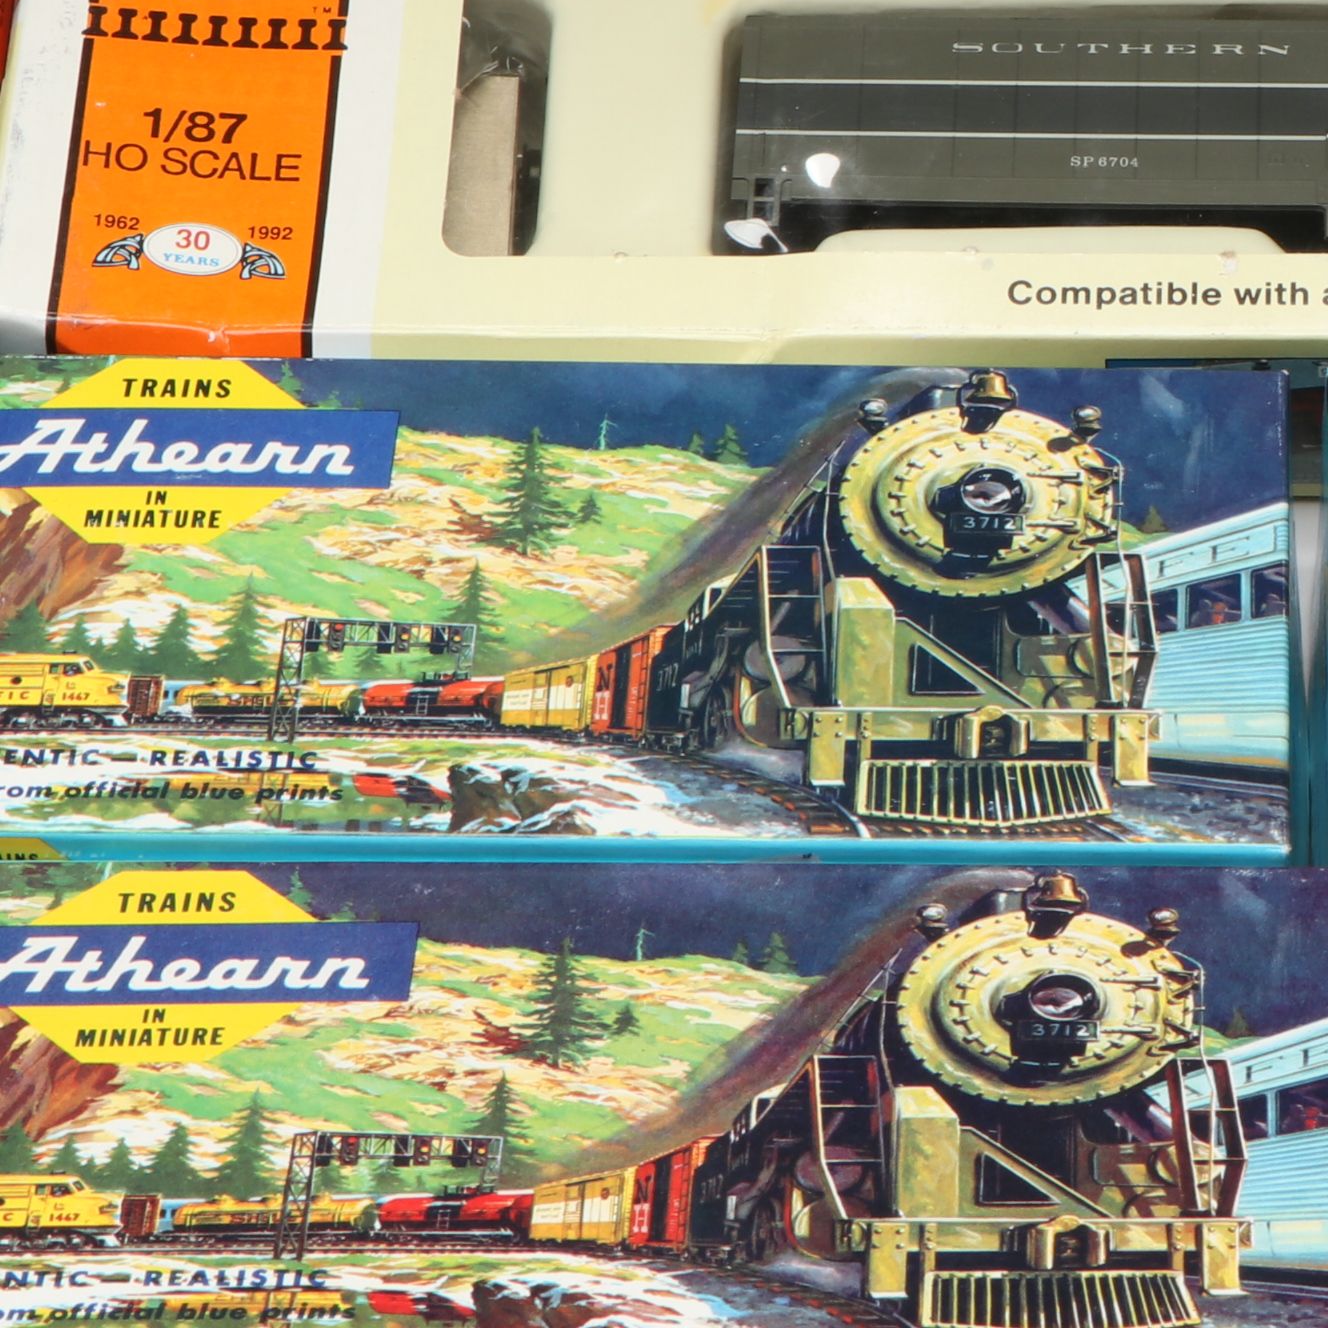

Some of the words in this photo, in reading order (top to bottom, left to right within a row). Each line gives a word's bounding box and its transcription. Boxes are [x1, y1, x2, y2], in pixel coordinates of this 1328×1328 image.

[949, 40, 1291, 57] SOUTHERN
[142, 107, 249, 146] 1/87
[81, 139, 149, 171] HO
[160, 147, 303, 183] SCALE
[1069, 154, 1095, 168] SP
[1098, 155, 1140, 168] 6704
[92, 213, 141, 230] 1962
[247, 224, 293, 241] 1992
[174, 227, 211, 251] 30
[162, 252, 221, 268] YEARS
[1006, 279, 1223, 312] Compatible
[1232, 281, 1310, 307] with
[121, 378, 233, 399] TRAINS
[0, 418, 355, 476] Athearn
[145, 490, 168, 506] IN
[83, 508, 223, 530] MINIATURE
[963, 515, 1017, 531] 3712
[61, 691, 91, 702] 1467
[150, 749, 319, 769] REALISTIC
[64, 780, 170, 800] official
[180, 781, 245, 800] blue
[255, 781, 344, 805] prints
[117, 891, 237, 914] TRAINS
[0, 935, 370, 993] Athearn
[142, 1008, 166, 1024] IN
[74, 1027, 226, 1048] MINIATURE
[1031, 1021, 1091, 1037] 3712
[49, 1212, 80, 1222] 1467
[142, 1269, 328, 1288] REALISTIC
[50, 1301, 166, 1323] official
[176, 1302, 247, 1321] blue
[259, 1301, 357, 1325] prints
